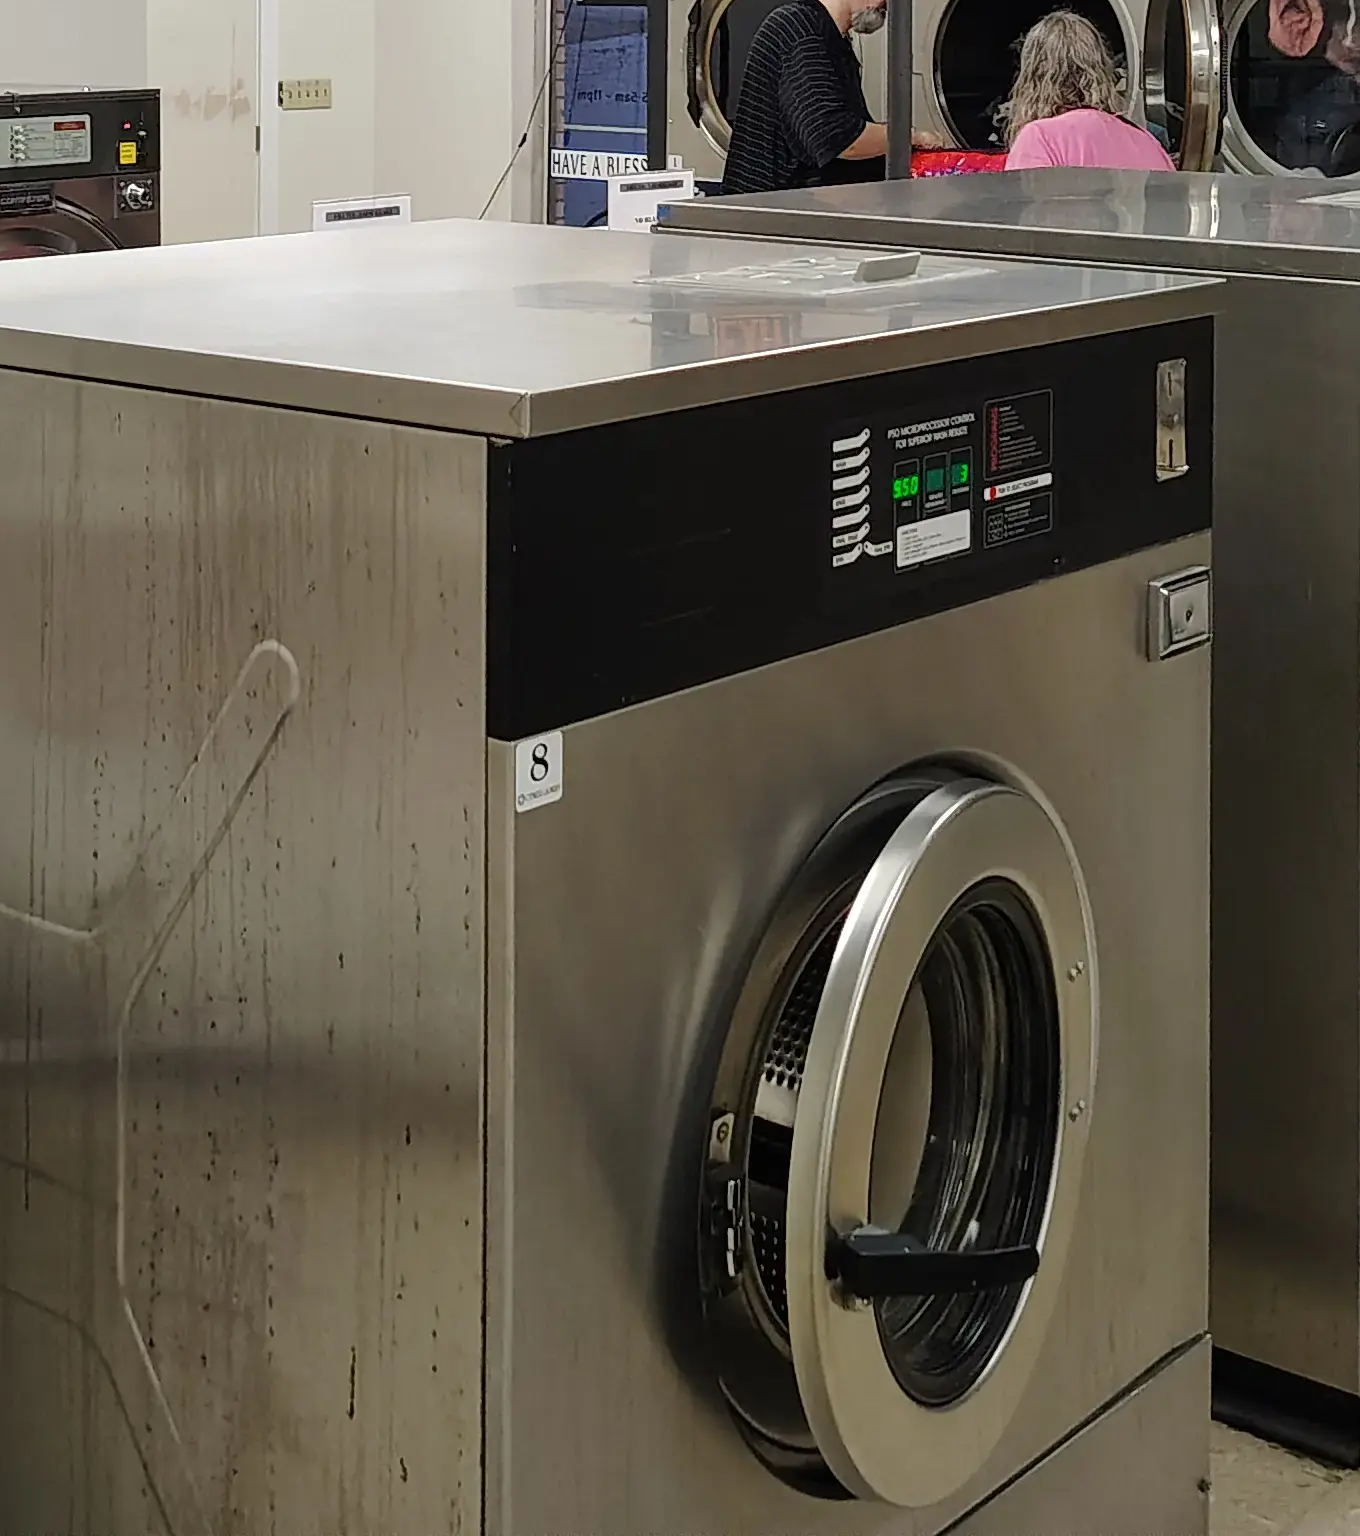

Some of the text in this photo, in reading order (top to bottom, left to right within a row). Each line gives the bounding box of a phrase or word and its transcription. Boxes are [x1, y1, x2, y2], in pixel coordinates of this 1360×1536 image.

[552, 153, 587, 175] HAVE
[592, 155, 601, 177] A
[530, 743, 549, 782] 8
